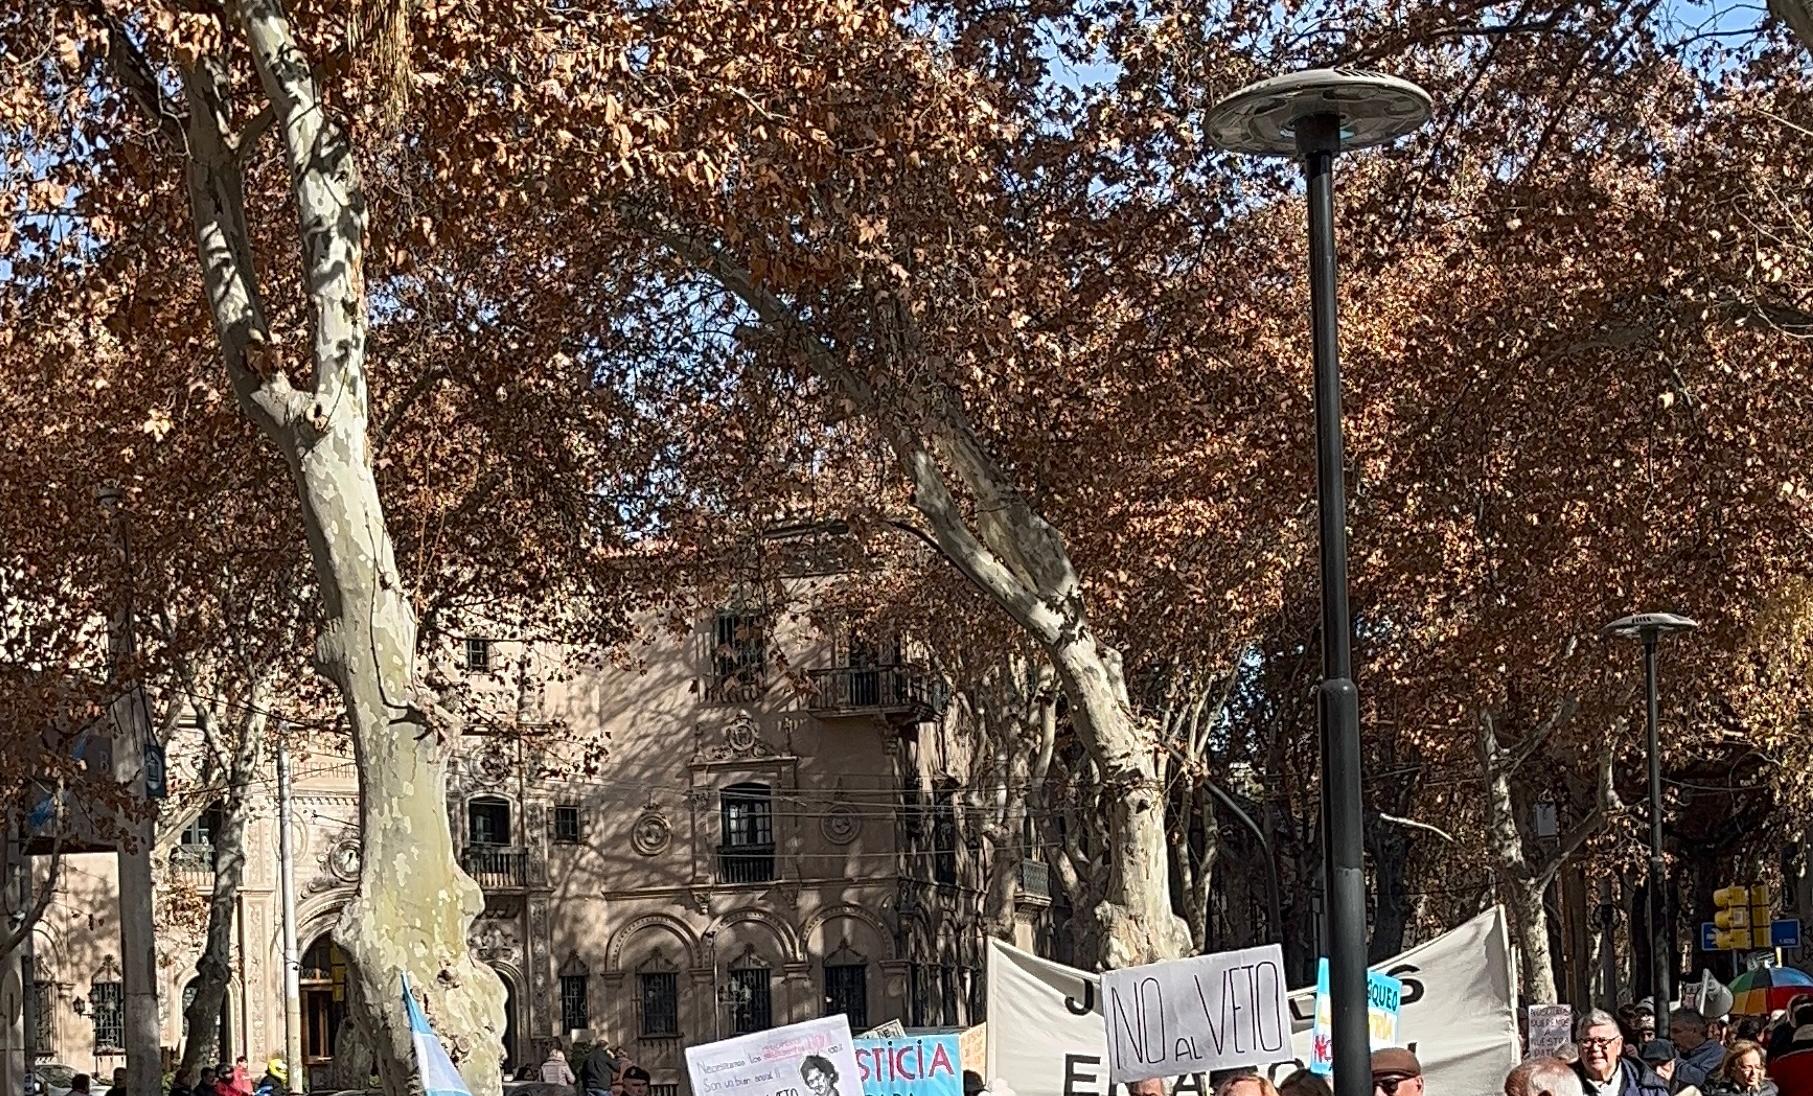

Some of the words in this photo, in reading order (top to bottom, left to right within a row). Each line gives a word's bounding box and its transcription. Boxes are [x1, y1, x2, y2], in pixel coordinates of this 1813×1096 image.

[1111, 977, 1166, 1070] NO
[1174, 1037, 1203, 1062] AL
[1194, 961, 1284, 1056] VETO
[855, 1040, 955, 1082] STICIA
